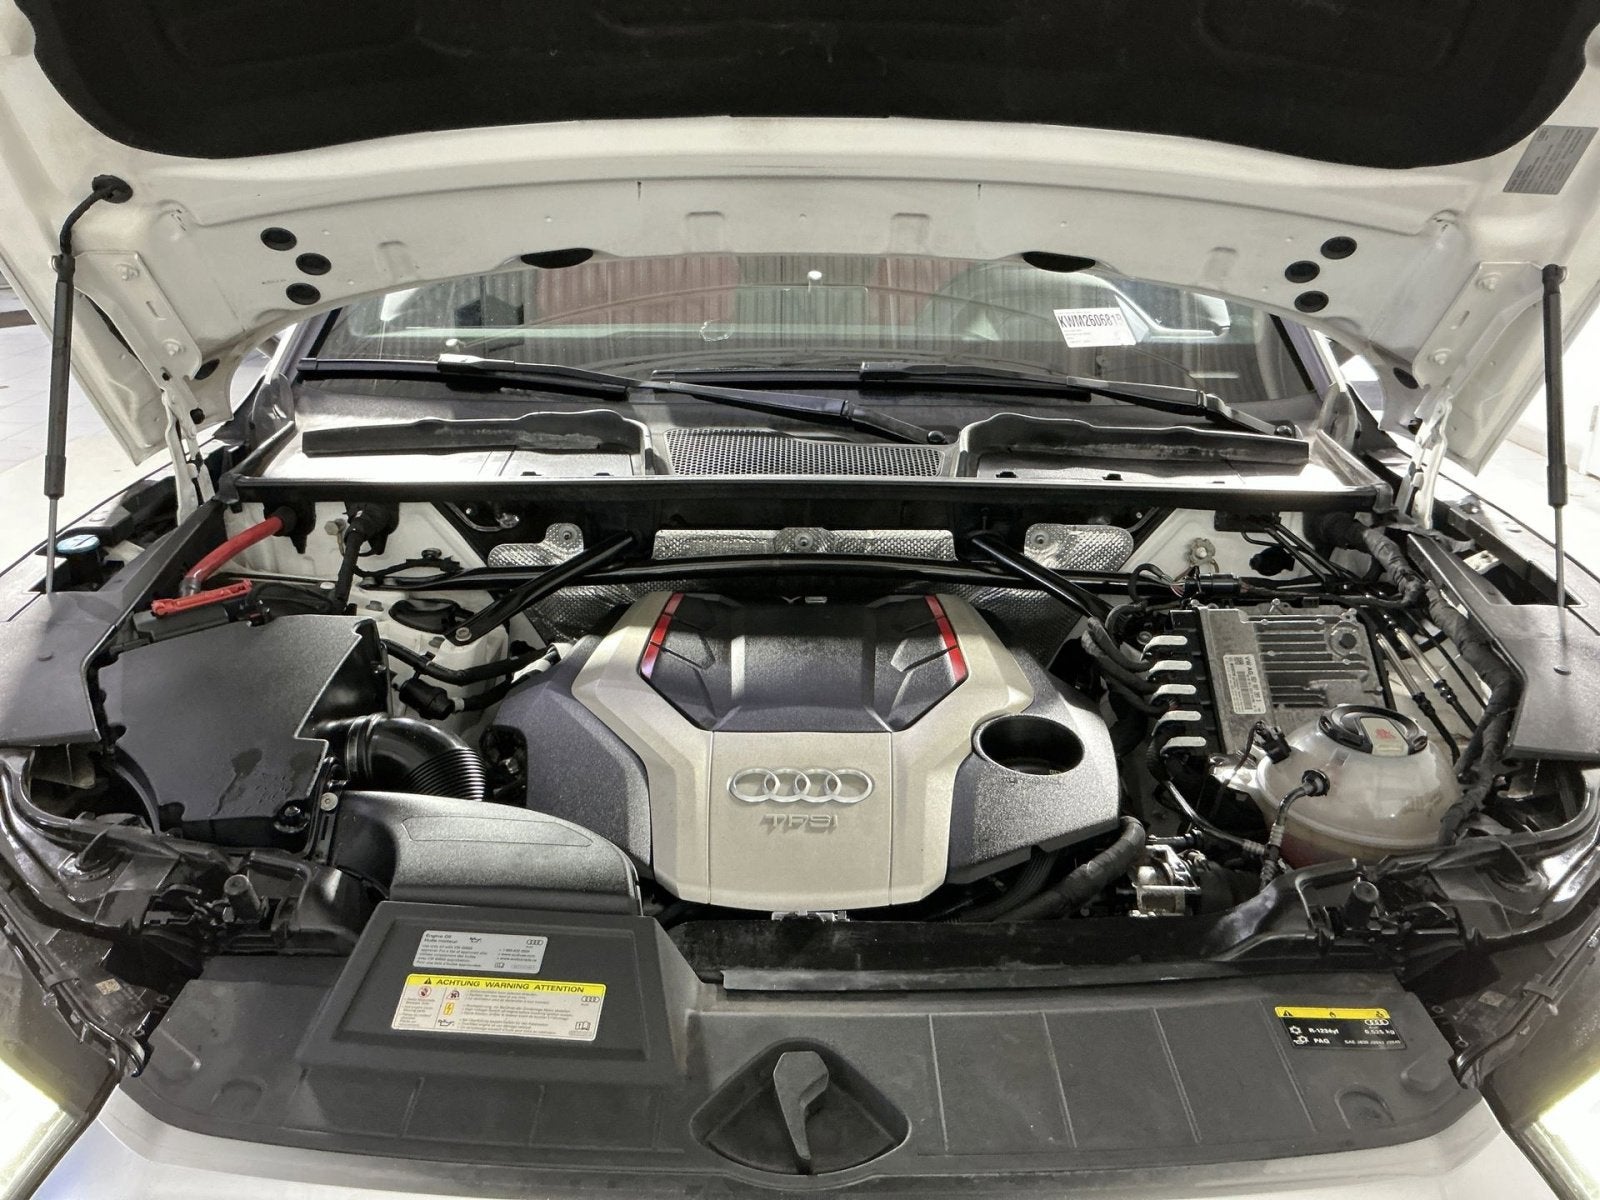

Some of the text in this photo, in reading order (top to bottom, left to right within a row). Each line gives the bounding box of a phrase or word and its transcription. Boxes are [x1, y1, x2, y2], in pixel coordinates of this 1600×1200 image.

[761, 813, 838, 831] TFSI
[436, 979, 584, 993] ACHTUNG WARNING ATTENTION
